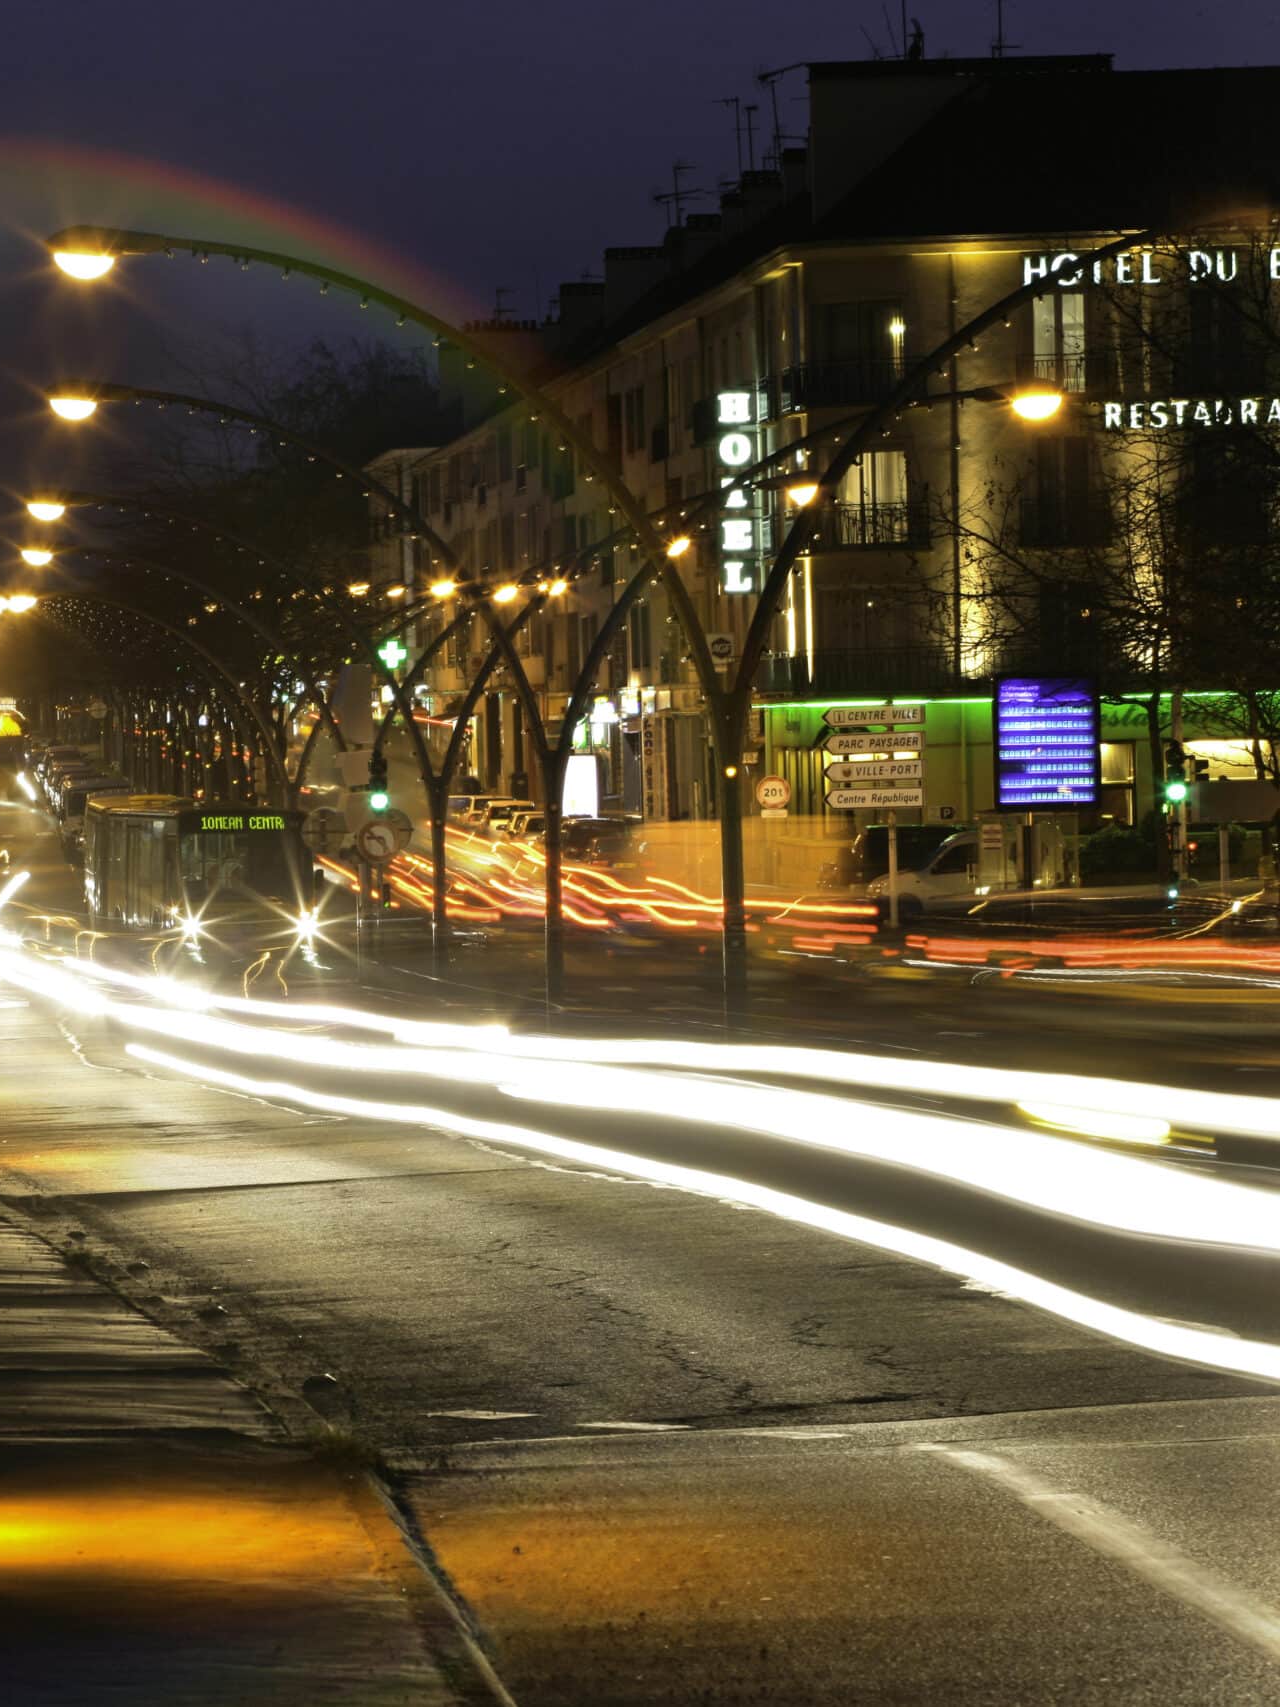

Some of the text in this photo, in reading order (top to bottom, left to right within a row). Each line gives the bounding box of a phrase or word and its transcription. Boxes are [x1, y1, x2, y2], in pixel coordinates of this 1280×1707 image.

[1189, 251, 1237, 281] DU
[847, 708, 918, 721] CENTRE VILLE
[838, 736, 919, 749] PARC PAYSAGER
[855, 764, 919, 777] VILLE-PORT
[837, 792, 920, 805] Centre République
